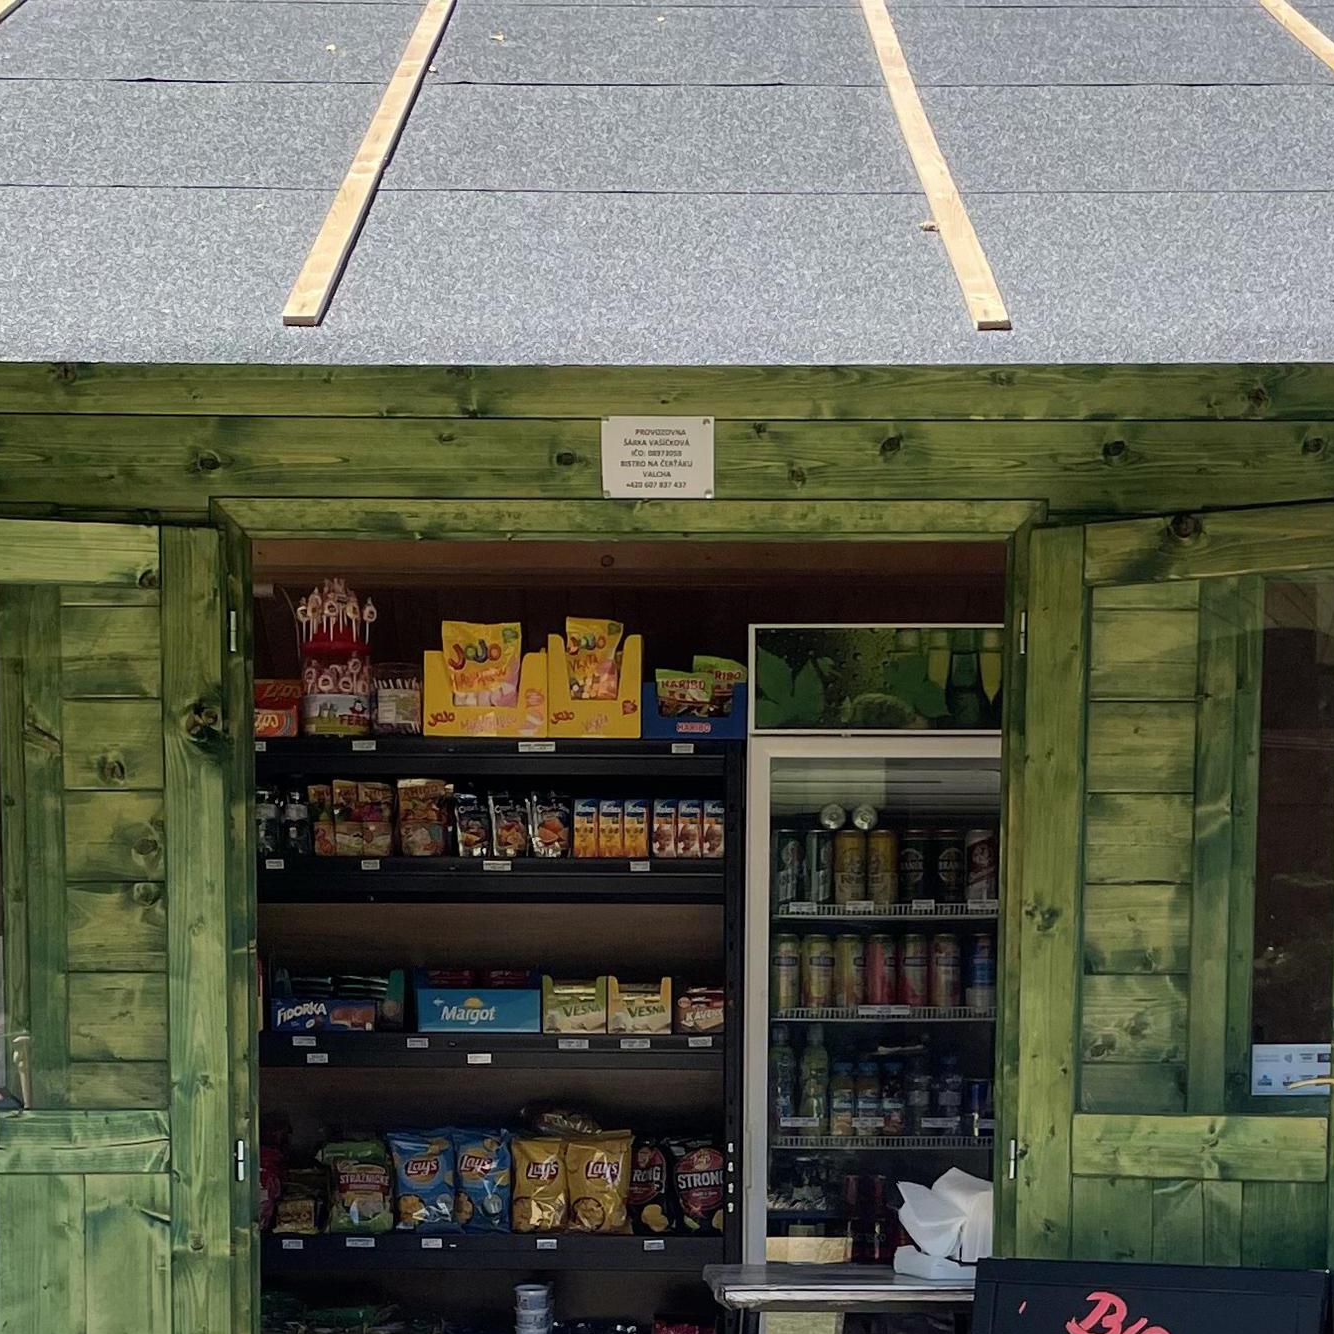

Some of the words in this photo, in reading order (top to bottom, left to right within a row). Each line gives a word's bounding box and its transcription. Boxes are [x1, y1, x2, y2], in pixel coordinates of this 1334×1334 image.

[634, 428, 687, 437] PROVOZOVNA
[620, 460, 646, 468] BISTRO
[647, 460, 659, 468] NA
[661, 679, 707, 691] HARIBO
[276, 1001, 328, 1027] FIDORKA
[440, 1005, 497, 1025] Margot
[562, 1003, 603, 1018] VESNA
[627, 1004, 667, 1018] VESNA
[632, 1166, 661, 1182] RONG
[677, 1170, 724, 1189] STRON
